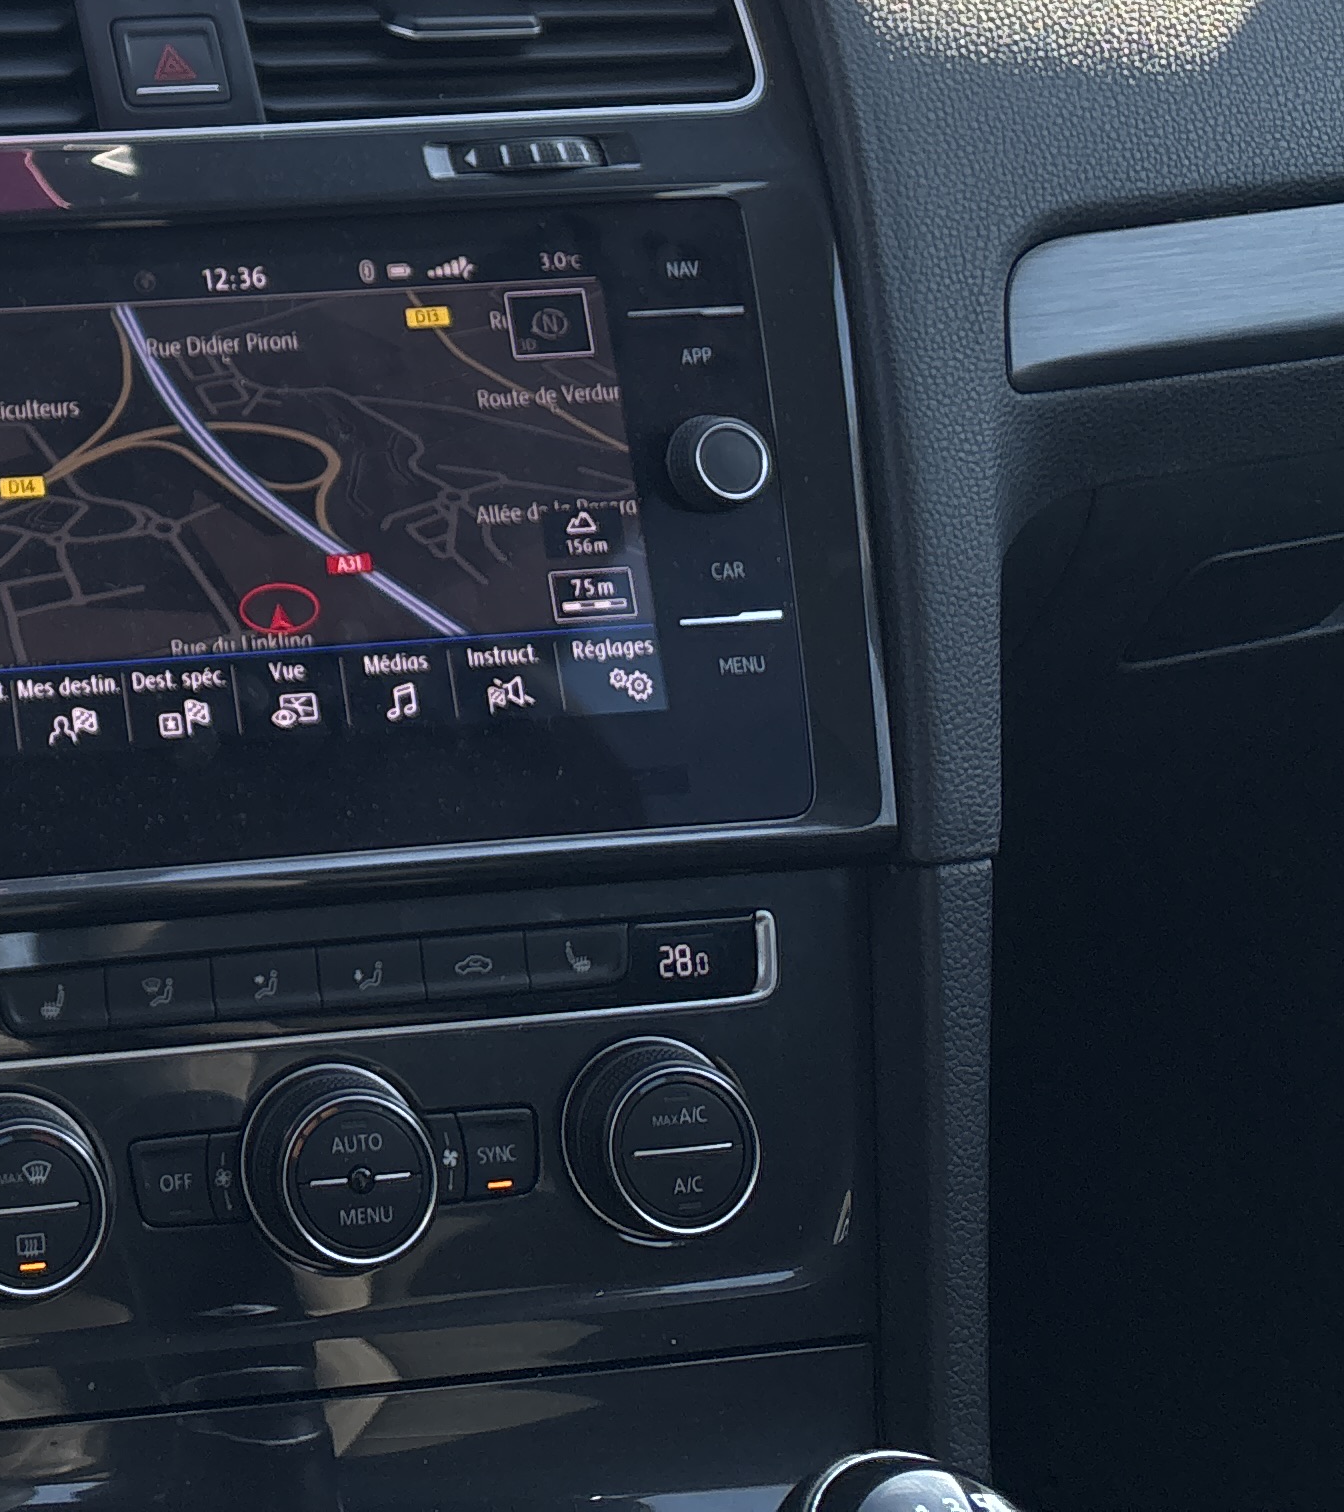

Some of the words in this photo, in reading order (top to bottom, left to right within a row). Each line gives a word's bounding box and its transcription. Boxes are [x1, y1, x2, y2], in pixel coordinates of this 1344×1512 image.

[202, 265, 268, 292] 12:36
[666, 259, 699, 278] NAV
[415, 307, 441, 326] D13
[146, 338, 182, 359] Rue
[186, 334, 240, 357] Didier
[246, 331, 300, 353] Pironi
[681, 346, 712, 365] APP
[477, 387, 530, 409] Route
[535, 386, 558, 404] de
[8, 479, 36, 495] D14
[476, 504, 523, 526] Allée
[337, 554, 362, 572] A31
[711, 561, 746, 580] CAR
[466, 644, 540, 668] Instruct.
[572, 636, 655, 663] Réglages
[268, 661, 308, 683] Vue
[363, 652, 429, 676] Médias
[719, 656, 766, 675] MENU
[17, 678, 55, 700] Mes
[58, 674, 121, 697] destin.
[131, 670, 178, 691] Dest.
[181, 666, 227, 691] spéc.
[658, 943, 710, 979] 28.0
[651, 1113, 679, 1128] MAX
[678, 1104, 708, 1125] A/C
[331, 1132, 383, 1155] AUTO
[477, 1144, 517, 1164] SYNC
[159, 1172, 194, 1192] OFF
[673, 1175, 704, 1195] A/C
[339, 1204, 394, 1226] MENU
